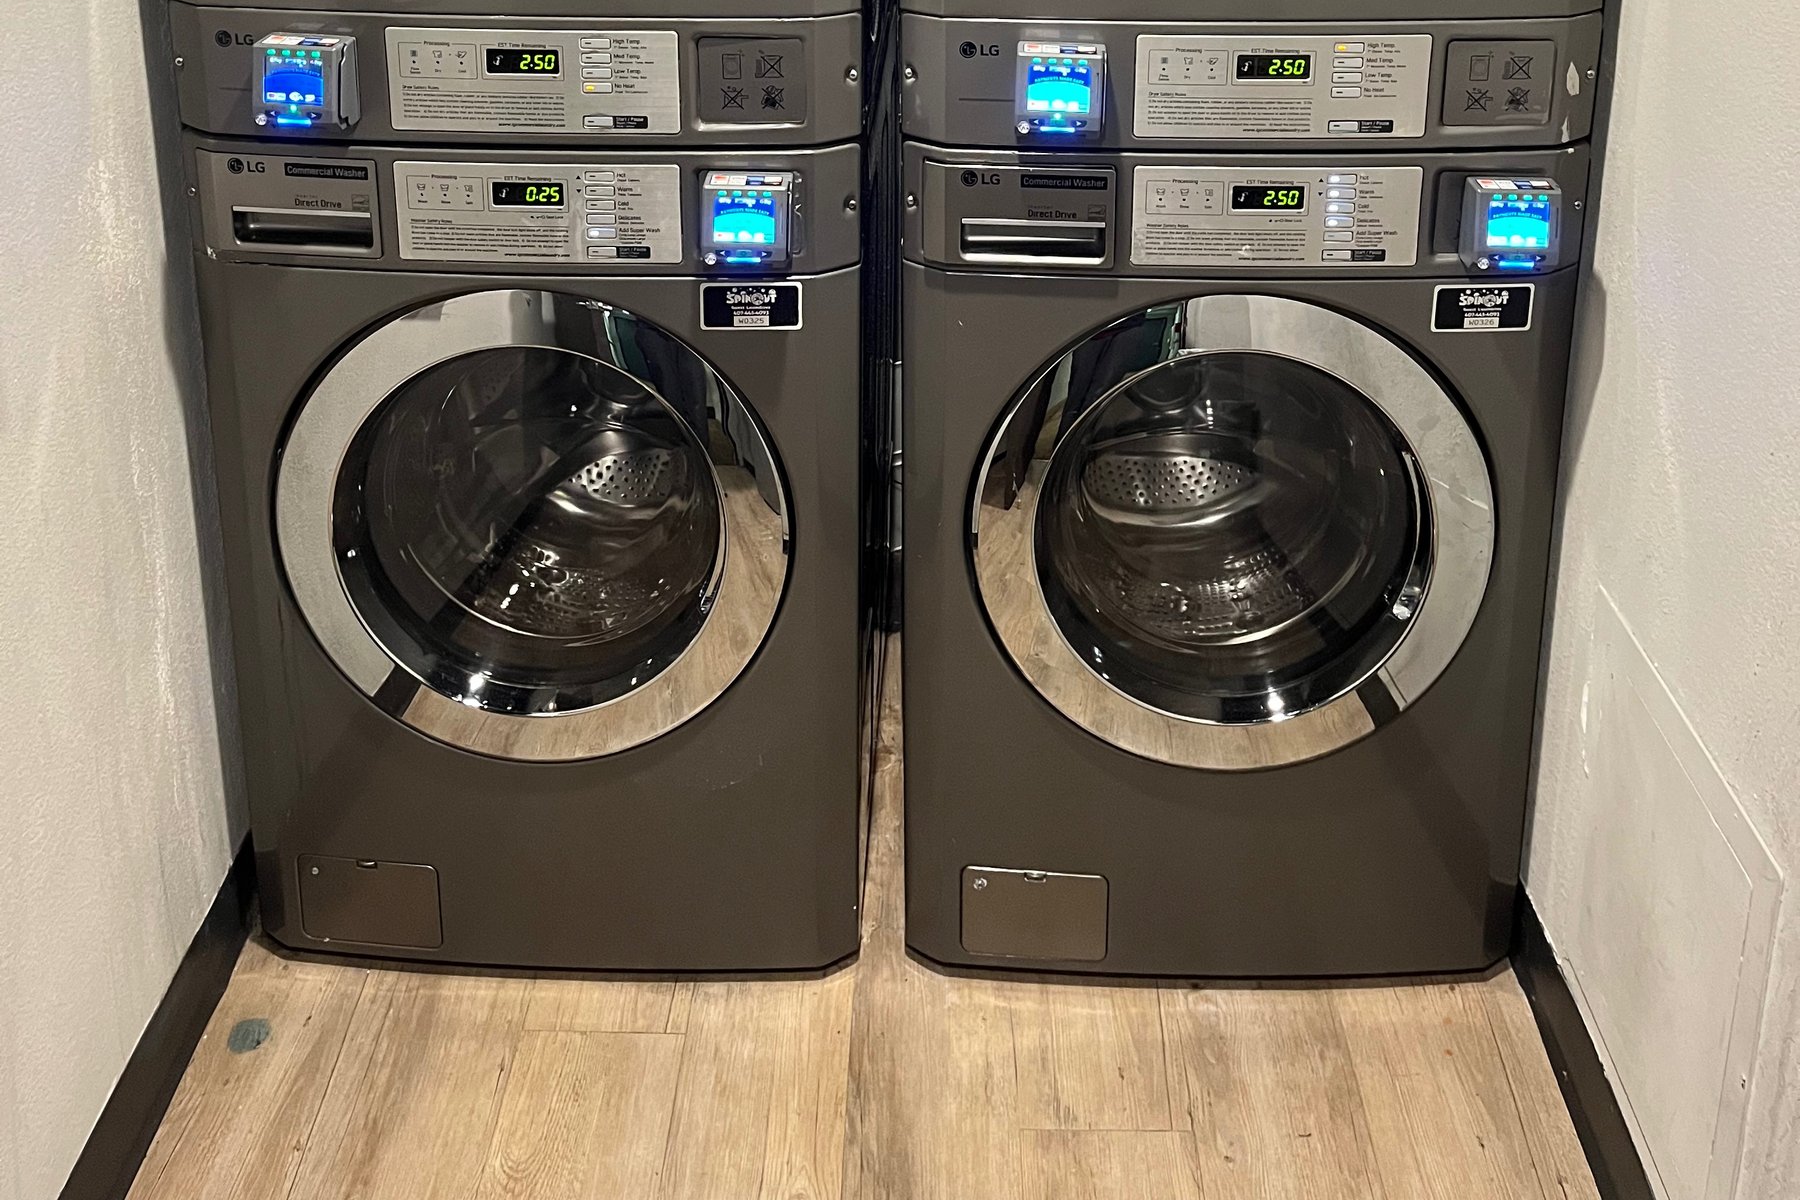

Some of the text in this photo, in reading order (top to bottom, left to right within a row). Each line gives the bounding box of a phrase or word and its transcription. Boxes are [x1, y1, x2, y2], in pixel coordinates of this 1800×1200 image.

[235, 34, 254, 45] LG
[980, 45, 999, 56] LG
[520, 54, 555, 70] 2.50
[1268, 59, 1306, 75] 2.50
[247, 161, 265, 173] LG
[287, 165, 366, 178] Commercial Washer
[981, 173, 1000, 185] LG
[1023, 177, 1106, 188] Commercial Washer
[525, 186, 560, 202] 0.25
[1263, 190, 1299, 206] 2.50
[294, 198, 342, 209] Direct Drive
[1027, 209, 1078, 219] Direct Drive
